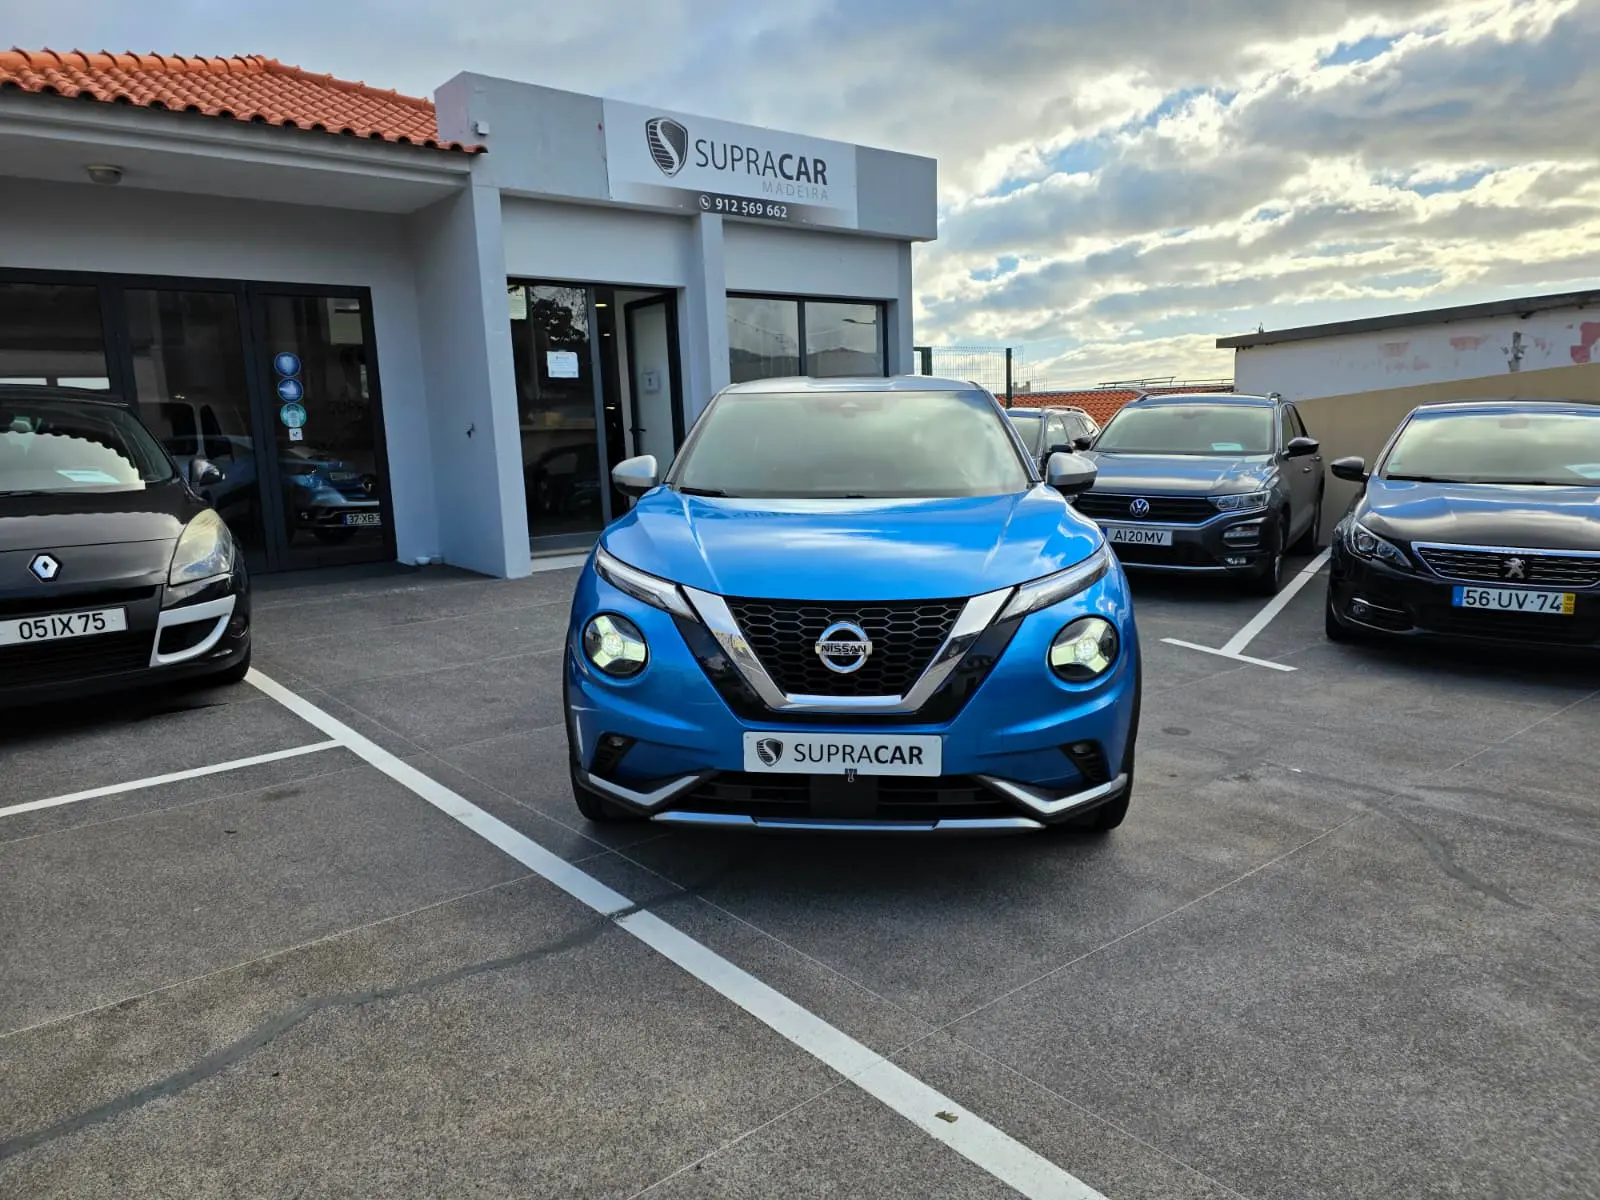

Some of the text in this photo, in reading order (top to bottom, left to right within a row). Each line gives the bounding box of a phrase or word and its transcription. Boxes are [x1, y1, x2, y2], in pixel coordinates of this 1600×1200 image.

[695, 139, 828, 185] SUPRACAR
[762, 181, 829, 200] MADEIRA
[715, 199, 787, 218] 912 569 662
[820, 643, 868, 656] NISSAN
[794, 743, 924, 765] SUPRACAR
